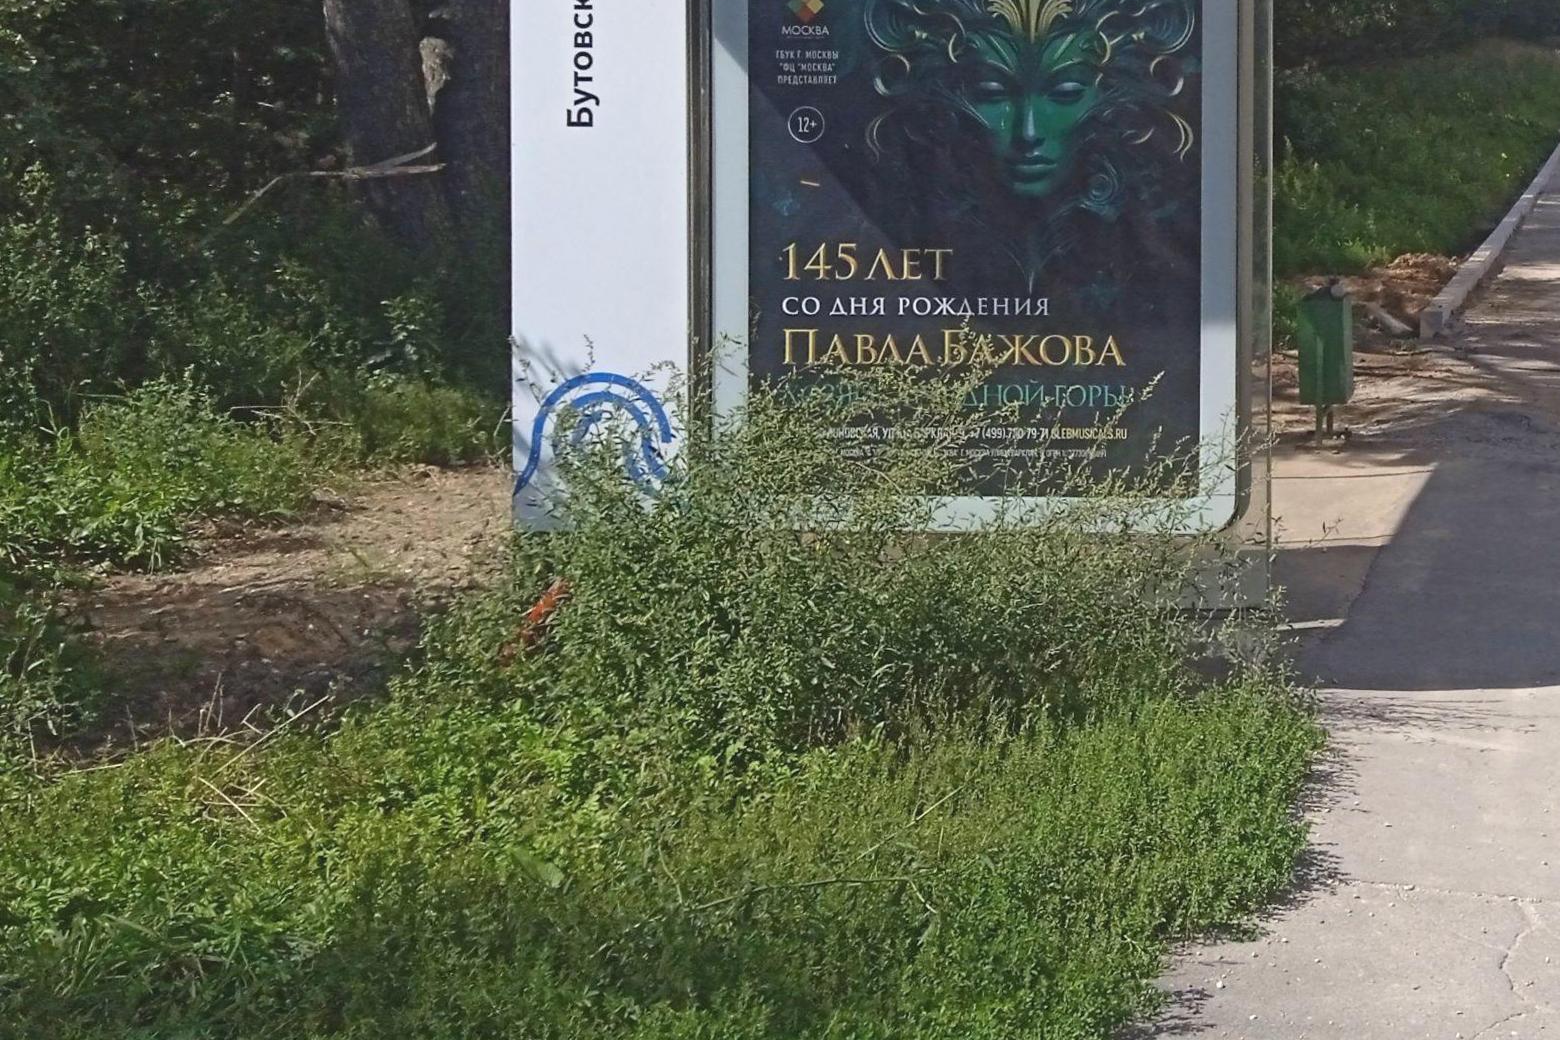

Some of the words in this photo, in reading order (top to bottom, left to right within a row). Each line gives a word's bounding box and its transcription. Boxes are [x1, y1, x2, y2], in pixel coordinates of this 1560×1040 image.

[781, 25, 830, 36] МОСКВА
[805, 50, 839, 60] МОСКВЫ
[777, 75, 837, 85] ПРЕДСТАВЛЯЕТ
[797, 116, 818, 133] 12+
[782, 241, 859, 281] 145
[864, 247, 954, 281] ЛЕТ
[781, 296, 821, 316] СО
[829, 296, 886, 316] ДНЯ
[898, 296, 1049, 316] РОЖДЕНИЯ
[782, 328, 934, 366] ПАВЛА
[940, 328, 1127, 367] БАЖОВА
[982, 427, 1006, 440] (499)
